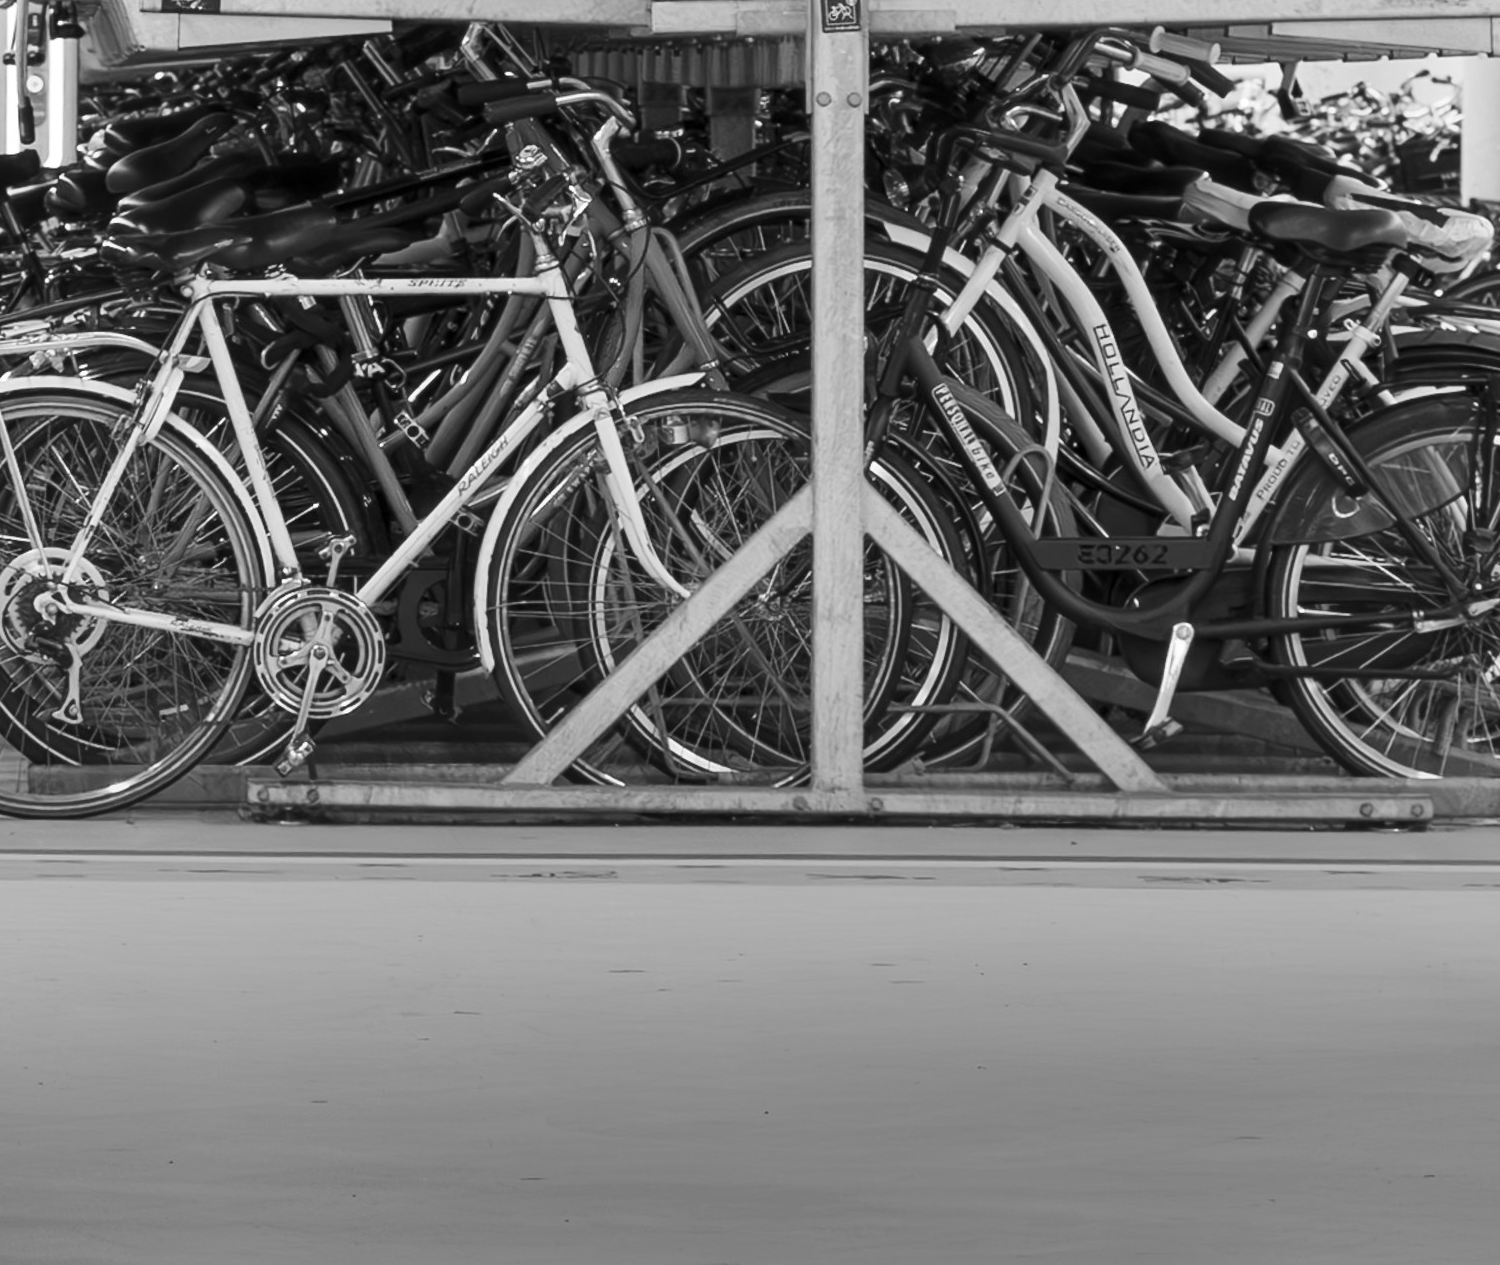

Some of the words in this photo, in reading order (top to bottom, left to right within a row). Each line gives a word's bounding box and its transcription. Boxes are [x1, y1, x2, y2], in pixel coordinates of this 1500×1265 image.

[934, 384, 978, 445] PERSONAL
[1093, 323, 1156, 470] HOLLANDIA
[456, 435, 510, 498] RALEIGH
[1228, 417, 1265, 502] BATAVUS
[1255, 458, 1288, 502] PROUD
